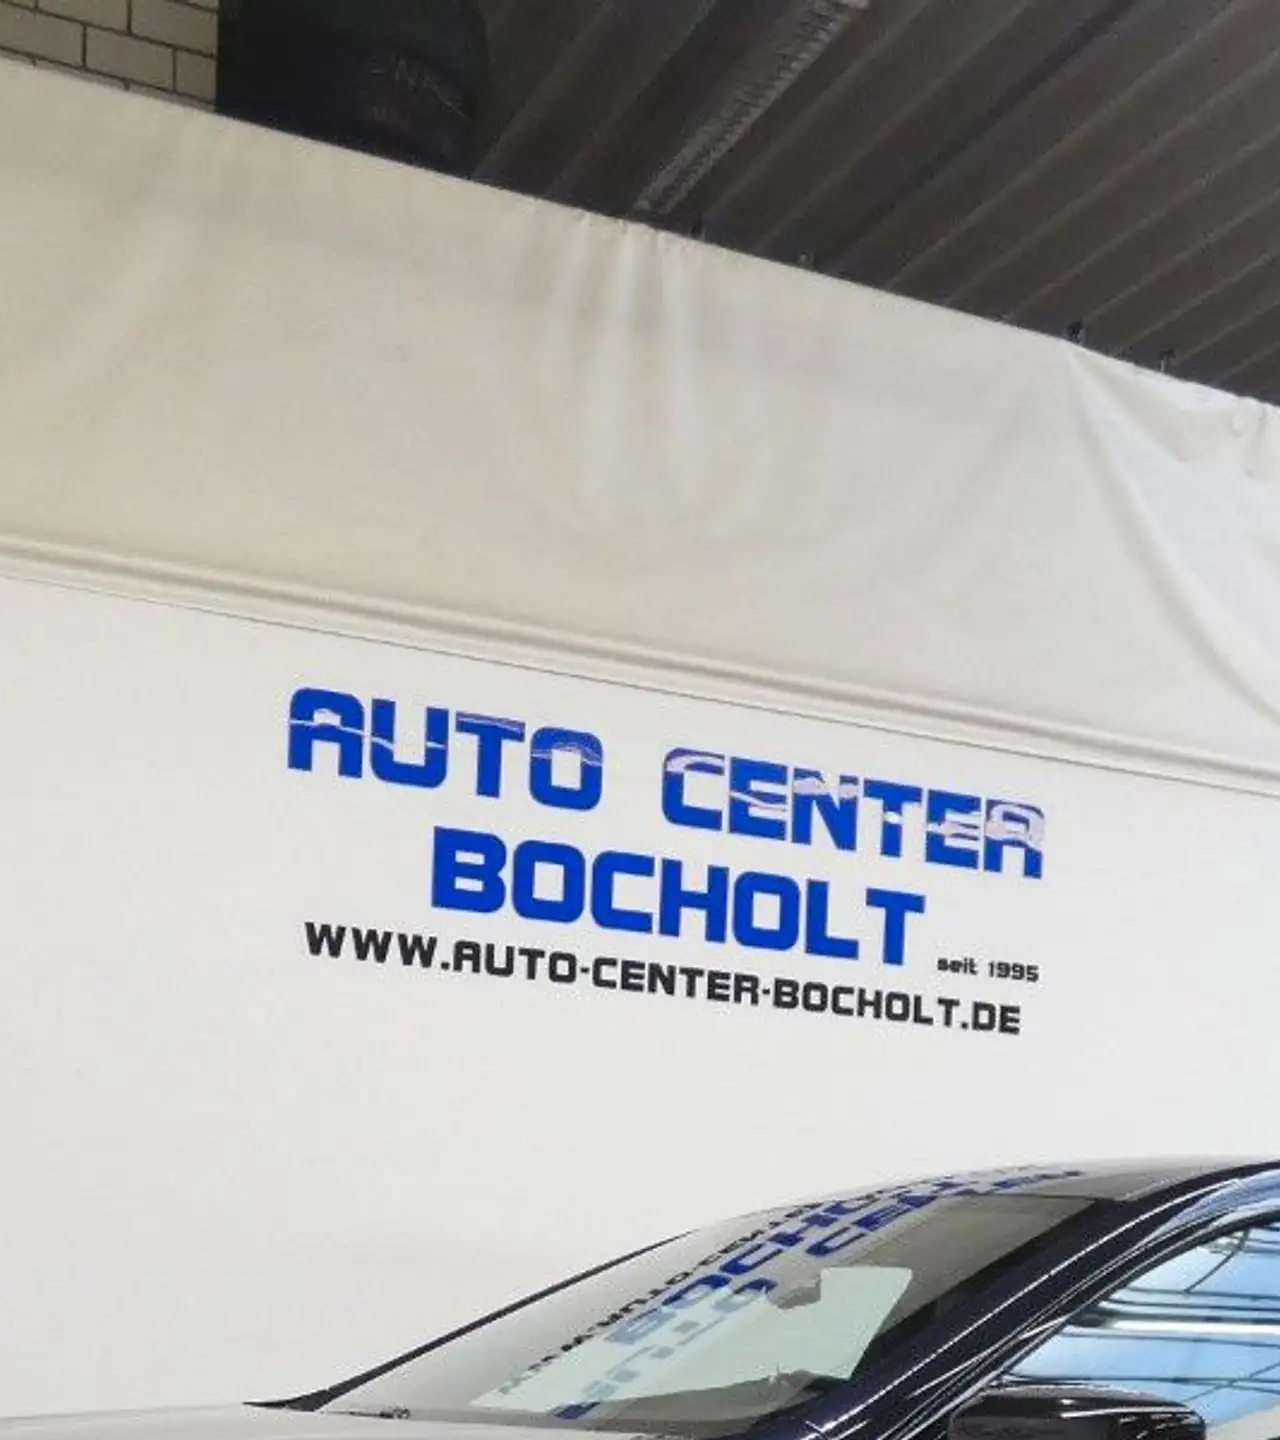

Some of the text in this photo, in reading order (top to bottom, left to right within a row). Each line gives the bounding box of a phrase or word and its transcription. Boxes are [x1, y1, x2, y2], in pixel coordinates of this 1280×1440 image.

[287, 687, 1044, 880] AUTO CENTER
[431, 827, 925, 966] BOCHOLT
[304, 921, 1021, 1036] WWW.AUTO-CENTER-BOCHOLT.DE
[937, 957, 1039, 983] seit 1995
